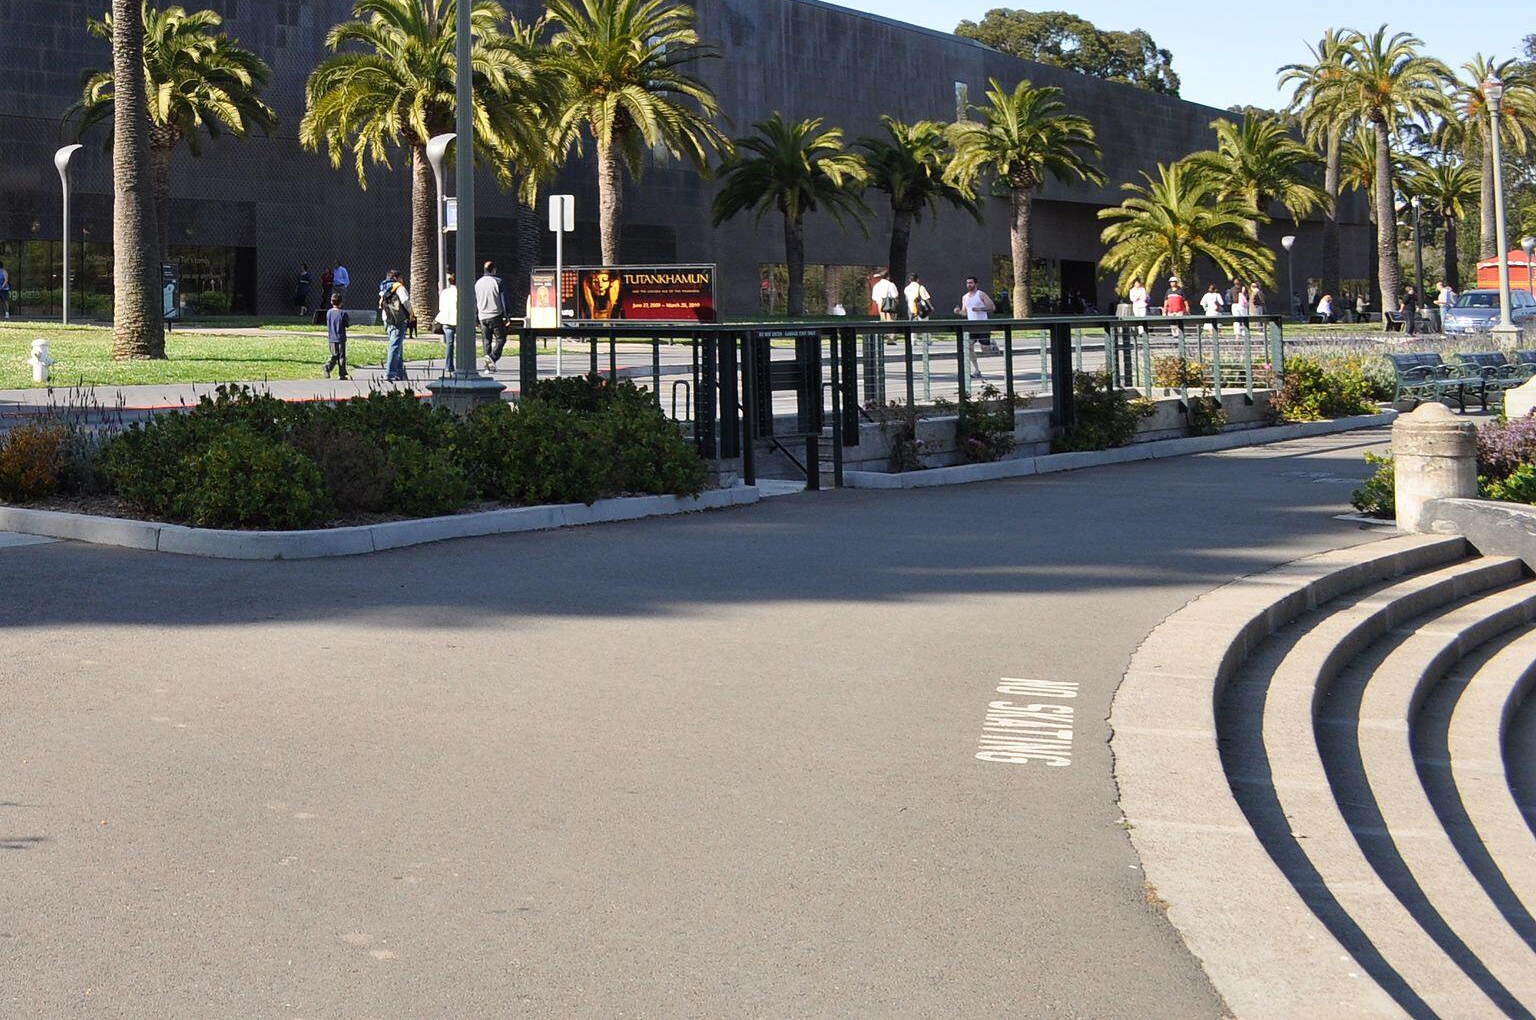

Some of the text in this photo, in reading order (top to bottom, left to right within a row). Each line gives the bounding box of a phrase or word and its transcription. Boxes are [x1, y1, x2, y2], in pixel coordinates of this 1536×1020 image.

[623, 273, 709, 284] TUTANKHAMUN
[974, 677, 1079, 767] NO SKATING
